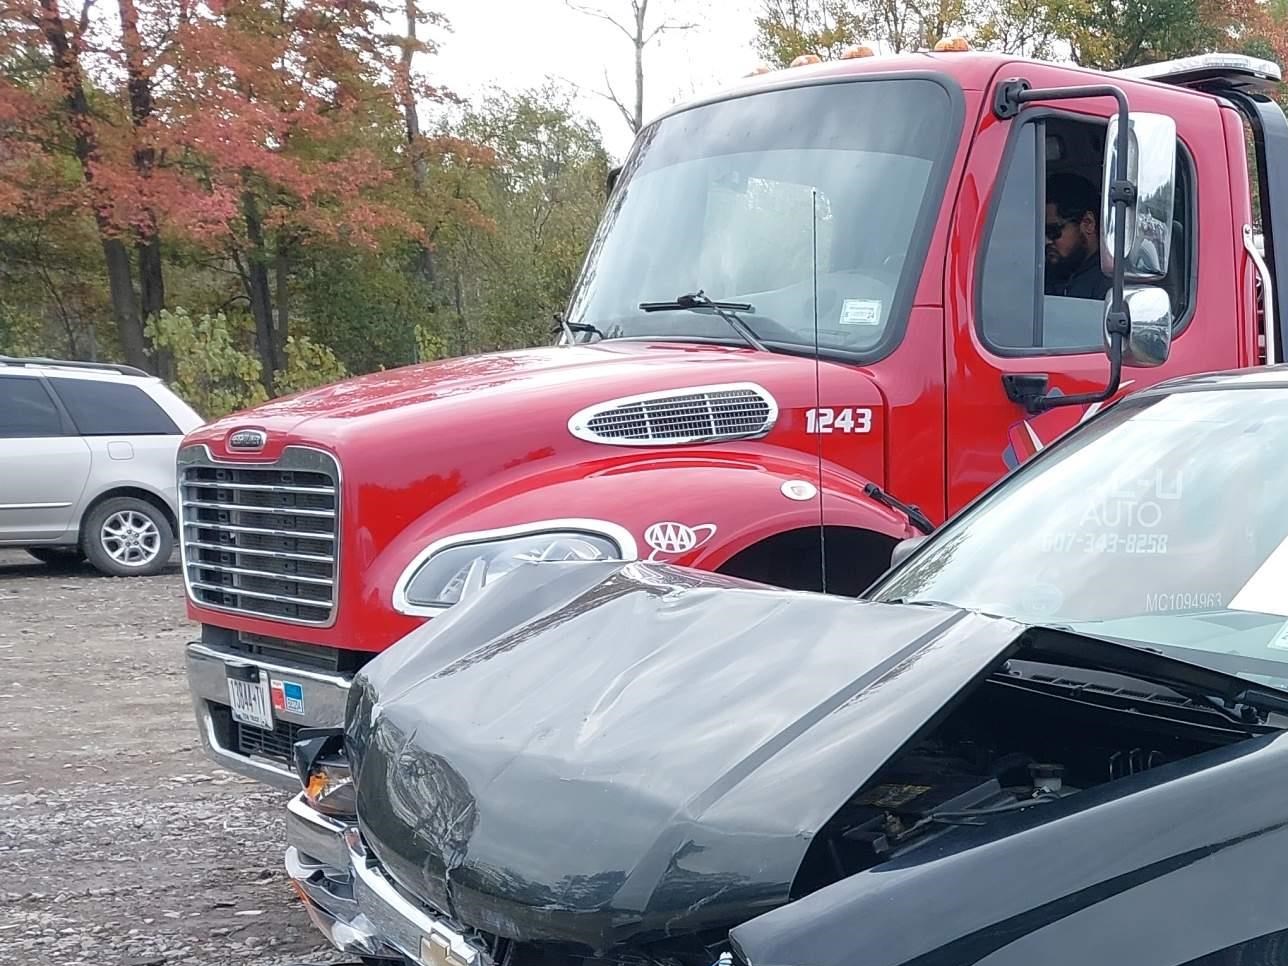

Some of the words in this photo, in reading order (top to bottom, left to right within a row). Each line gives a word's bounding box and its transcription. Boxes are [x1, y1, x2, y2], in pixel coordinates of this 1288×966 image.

[805, 408, 872, 433] 1243
[1079, 500, 1163, 527] AUTO
[650, 524, 691, 551] AAA
[1145, 592, 1222, 612] MC1094963
